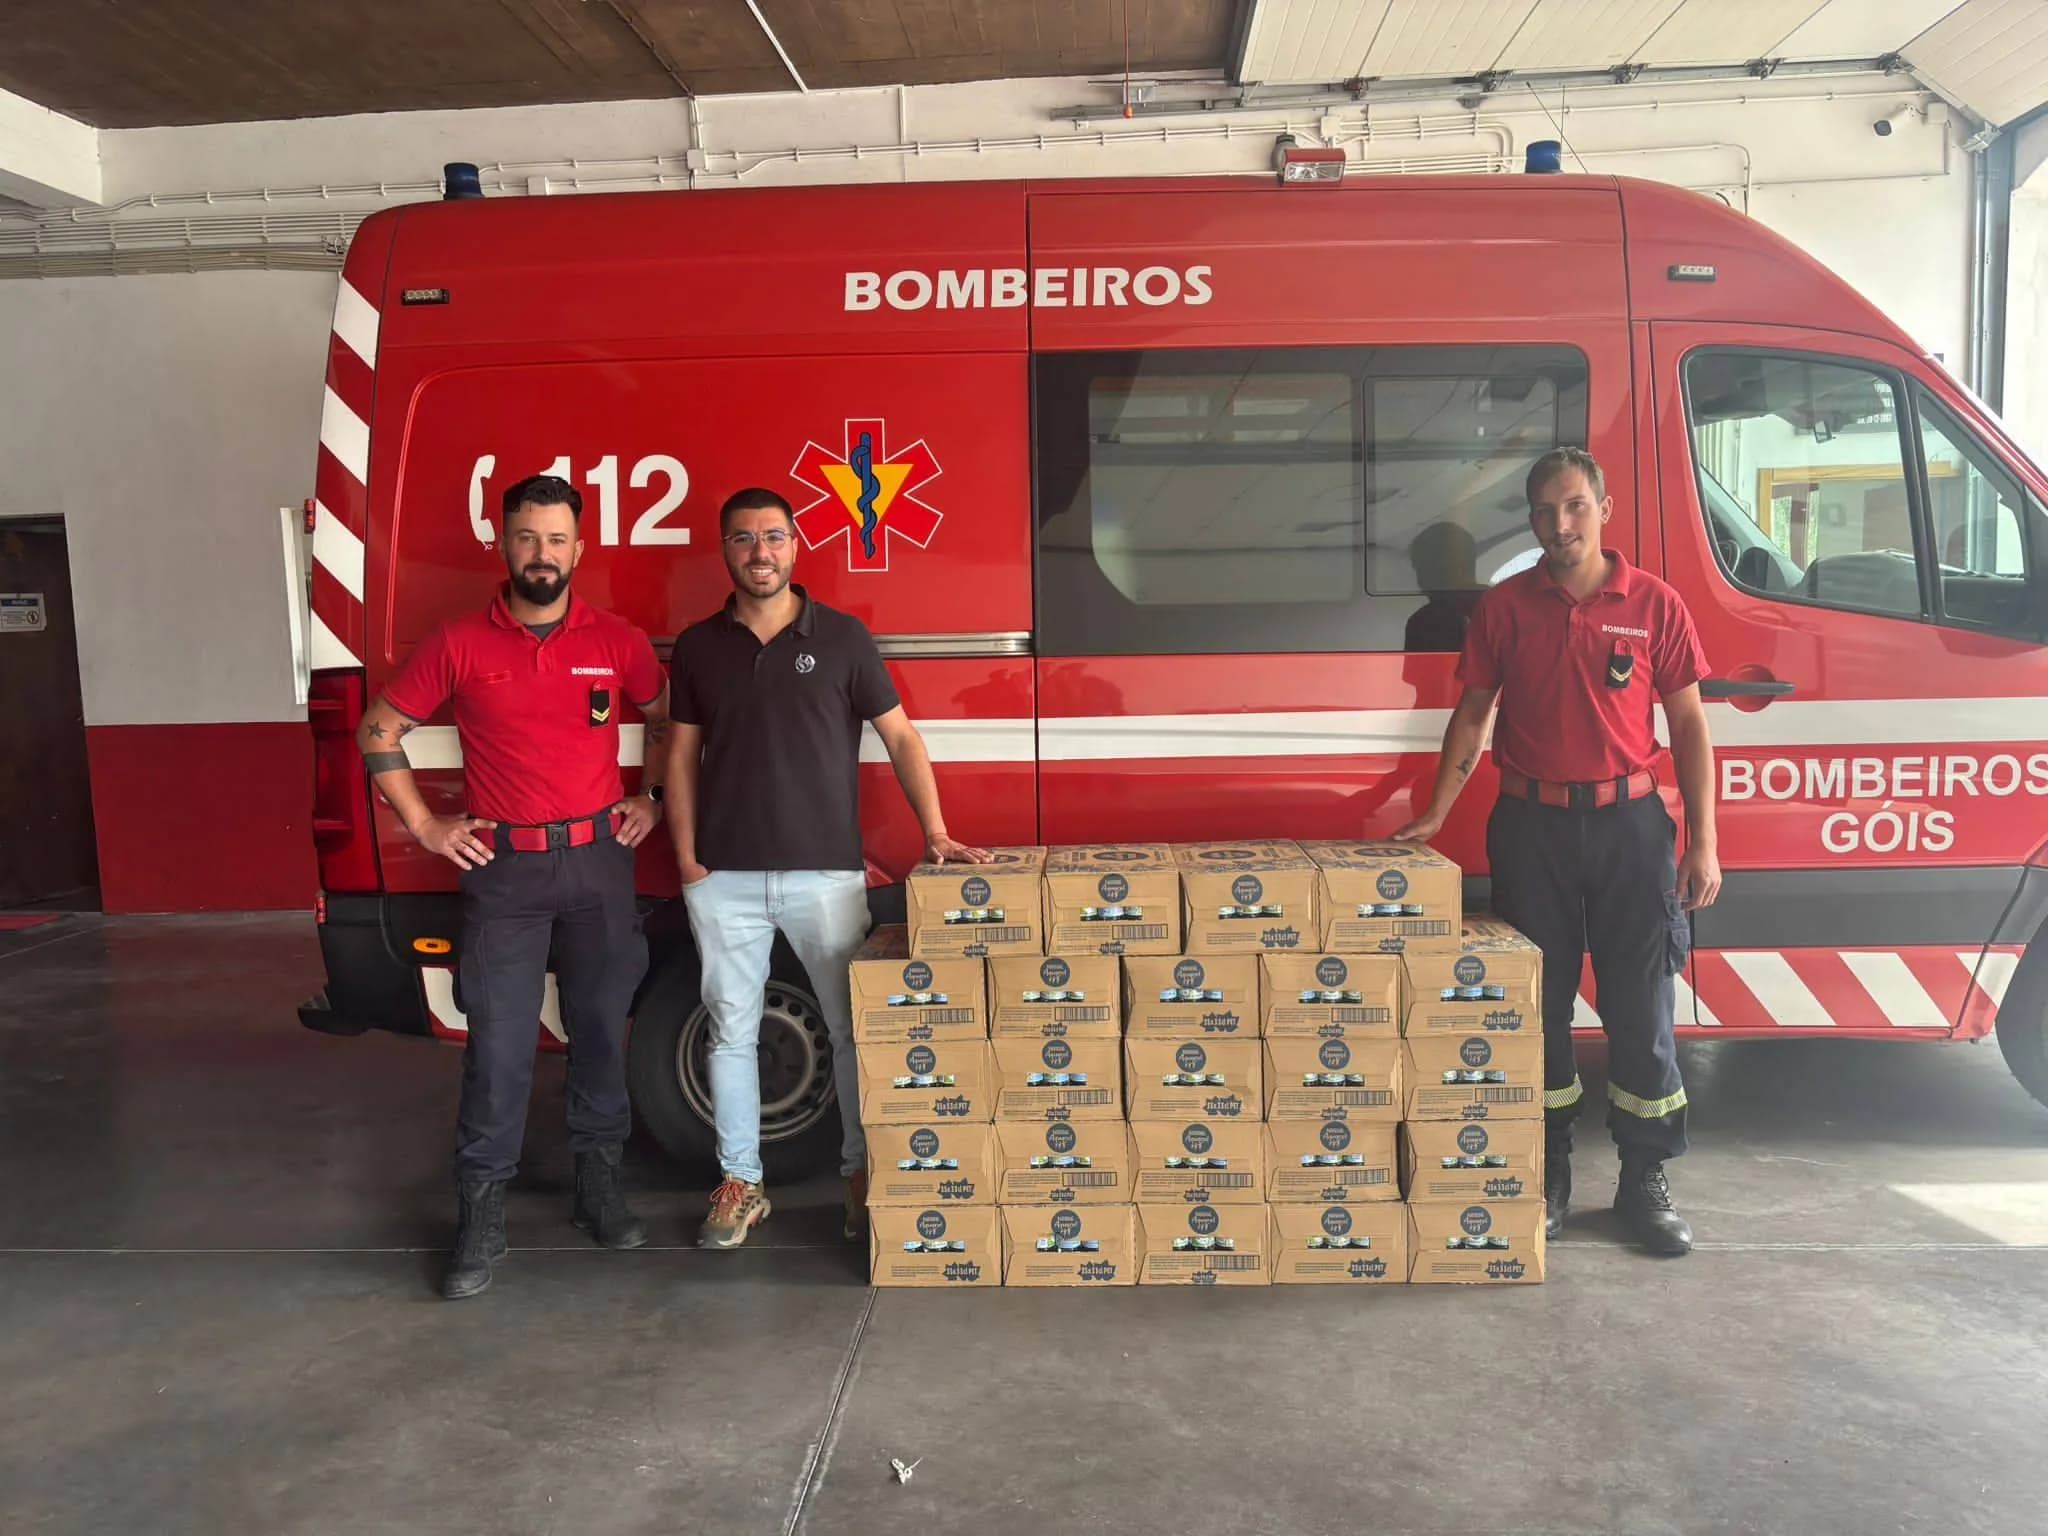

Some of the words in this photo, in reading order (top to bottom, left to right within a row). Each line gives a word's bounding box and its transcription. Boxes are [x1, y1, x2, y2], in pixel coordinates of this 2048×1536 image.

[843, 265, 1213, 311] BOMBEIROS
[1602, 624, 1648, 638] BOMBEIROS
[571, 667, 614, 676] BOMBEIROS
[1721, 753, 2048, 800] BOMBEIROS
[1821, 800, 1955, 853] GÓIS
